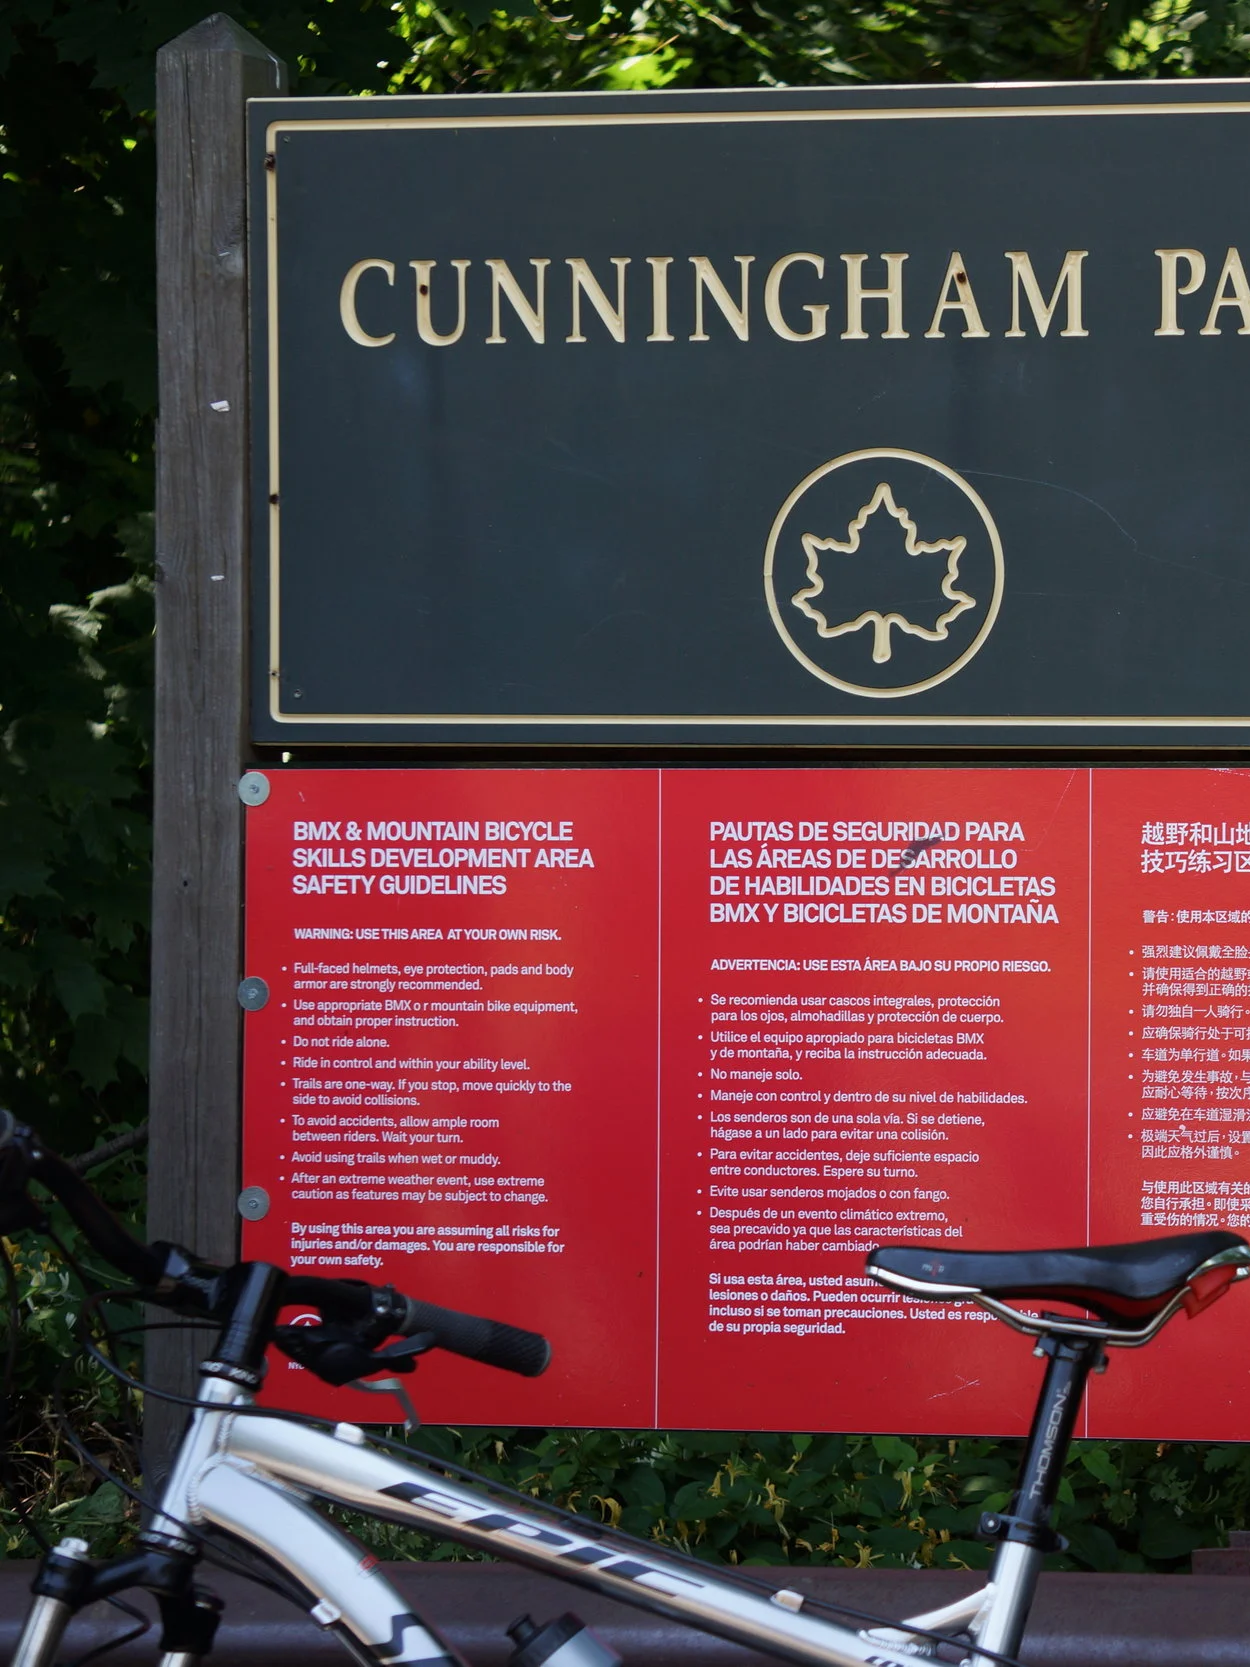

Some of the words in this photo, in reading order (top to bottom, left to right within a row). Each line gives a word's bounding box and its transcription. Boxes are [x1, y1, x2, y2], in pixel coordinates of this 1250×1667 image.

[340, 250, 1089, 347] CUNNINGHAM
[293, 821, 341, 840] BMX
[345, 821, 362, 841] &
[367, 820, 479, 841] MOUNTAIN
[484, 820, 573, 841] BICYCLE
[710, 821, 793, 841] PAUTAS
[798, 821, 828, 841] DE
[832, 821, 960, 841] SEGURIDAD
[965, 821, 1025, 841] PARA
[292, 847, 366, 868] SKILLS
[370, 847, 531, 868] DEVELOPMENT
[533, 848, 595, 868] AREA
[710, 848, 752, 868] LAS
[755, 843, 831, 869] ÁREAS
[836, 848, 866, 868] DE
[871, 848, 1017, 869] DESARROLLO
[292, 874, 376, 894] SAFETY
[379, 874, 507, 895] GUIDELINES
[710, 875, 740, 895] DE
[744, 875, 890, 896] HABILIDADES
[894, 875, 925, 896] EN
[930, 875, 1056, 897] BICICLETAS
[710, 902, 760, 922] BMX
[762, 903, 779, 922] Y
[783, 902, 907, 923] BICICLETAS
[911, 903, 942, 923] DE
[946, 898, 1059, 923] MONTAÑA
[293, 927, 353, 939] WARNING:
[355, 927, 380, 940] USE
[380, 928, 409, 940] THIS
[409, 928, 443, 940] AREA
[446, 928, 463, 940] AT
[463, 928, 497, 940] YOUR
[498, 928, 527, 940] OWN
[529, 928, 562, 940] RISK.
[293, 962, 350, 974] Full-faced
[352, 962, 401, 976] helmets,
[403, 965, 424, 977] eye
[425, 962, 488, 977] protection,
[489, 963, 519, 977] pads
[520, 963, 543, 975] and
[545, 963, 574, 978] body
[710, 958, 800, 970] ADVERTENCIA:
[802, 959, 828, 971] USE
[830, 959, 862, 971] ESTA
[862, 957, 898, 971] ÁREA
[899, 959, 932, 971] BAJO
[933, 959, 951, 971] SU
[953, 959, 1000, 972] PROPIO
[1001, 960, 1051, 972] RIESGO.
[293, 980, 328, 989] armor
[329, 980, 348, 989] are
[349, 978, 396, 992] strongly
[397, 978, 483, 990] recommended.
[710, 993, 726, 1005] Se
[728, 993, 798, 1005] recomienda
[800, 996, 827, 1006] usar
[828, 996, 870, 1006] cascos
[873, 994, 934, 1008] integrales,
[937, 994, 1000, 1008] protección
[293, 1014, 315, 1026] and
[316, 1014, 352, 1026] obtain
[354, 1017, 393, 1029] proper
[394, 1014, 459, 1027] instruction.
[711, 1011, 738, 1024] para
[740, 1009, 758, 1021] los
[759, 1009, 787, 1024] ojos,
[790, 1009, 865, 1022] almohadillas
[866, 1012, 875, 1024] y
[876, 1010, 939, 1024] protección
[941, 1010, 957, 1022] de
[959, 1013, 1004, 1025] cuerpo.
[293, 1035, 309, 1047] Do
[310, 1036, 330, 1047] not
[331, 1035, 354, 1047] ride
[355, 1035, 390, 1047] alone.
[293, 1056, 318, 1068] Ride
[320, 1059, 330, 1068] in
[332, 1057, 373, 1068] control
[374, 1057, 396, 1069] and
[398, 1057, 433, 1069] within
[435, 1060, 461, 1072] your
[462, 1057, 499, 1072] ability
[500, 1058, 530, 1070] level.
[710, 1067, 727, 1079] No
[729, 1070, 773, 1082] maneje
[775, 1068, 802, 1080] solo.
[291, 1114, 305, 1126] To
[306, 1114, 337, 1126] avoid
[338, 1114, 397, 1128] accidents,
[399, 1115, 430, 1127] allow
[431, 1115, 467, 1130] ample
[469, 1118, 499, 1128] room
[292, 1129, 341, 1141] between
[343, 1130, 379, 1142] riders.
[381, 1130, 408, 1143] Wait
[408, 1133, 435, 1145] your
[435, 1132, 463, 1143] turn.
[290, 1151, 322, 1162] Avoid
[324, 1151, 355, 1166] using
[355, 1151, 386, 1163] trails
[387, 1151, 419, 1164] when
[420, 1153, 443, 1164] wet
[444, 1155, 457, 1164] or
[459, 1153, 501, 1167] muddy.
[710, 1148, 737, 1159] Para
[739, 1149, 773, 1160] evitar
[775, 1148, 843, 1163] accidentes,
[845, 1149, 871, 1163] deje
[872, 1149, 931, 1162] suficiente
[933, 1150, 979, 1164] espacio
[709, 1164, 741, 1175] entre
[743, 1164, 820, 1176] conductores.
[823, 1164, 864, 1178] Espere
[866, 1167, 881, 1177] su
[882, 1166, 918, 1178] turno.
[709, 1184, 739, 1197] Evite
[741, 1187, 768, 1197] usar
[769, 1186, 824, 1198] senderos
[826, 1186, 877, 1200] mojados
[878, 1189, 887, 1199] o
[888, 1189, 911, 1199] con
[913, 1187, 950, 1201] fango.
[290, 1255, 317, 1267] your
[317, 1255, 342, 1265] own
[343, 1253, 384, 1268] safety.
[708, 1320, 724, 1332] de
[725, 1322, 740, 1332] su
[742, 1321, 781, 1335] propia
[783, 1321, 845, 1336] seguridad.
[1029, 1393, 1067, 1500] THOMSON
